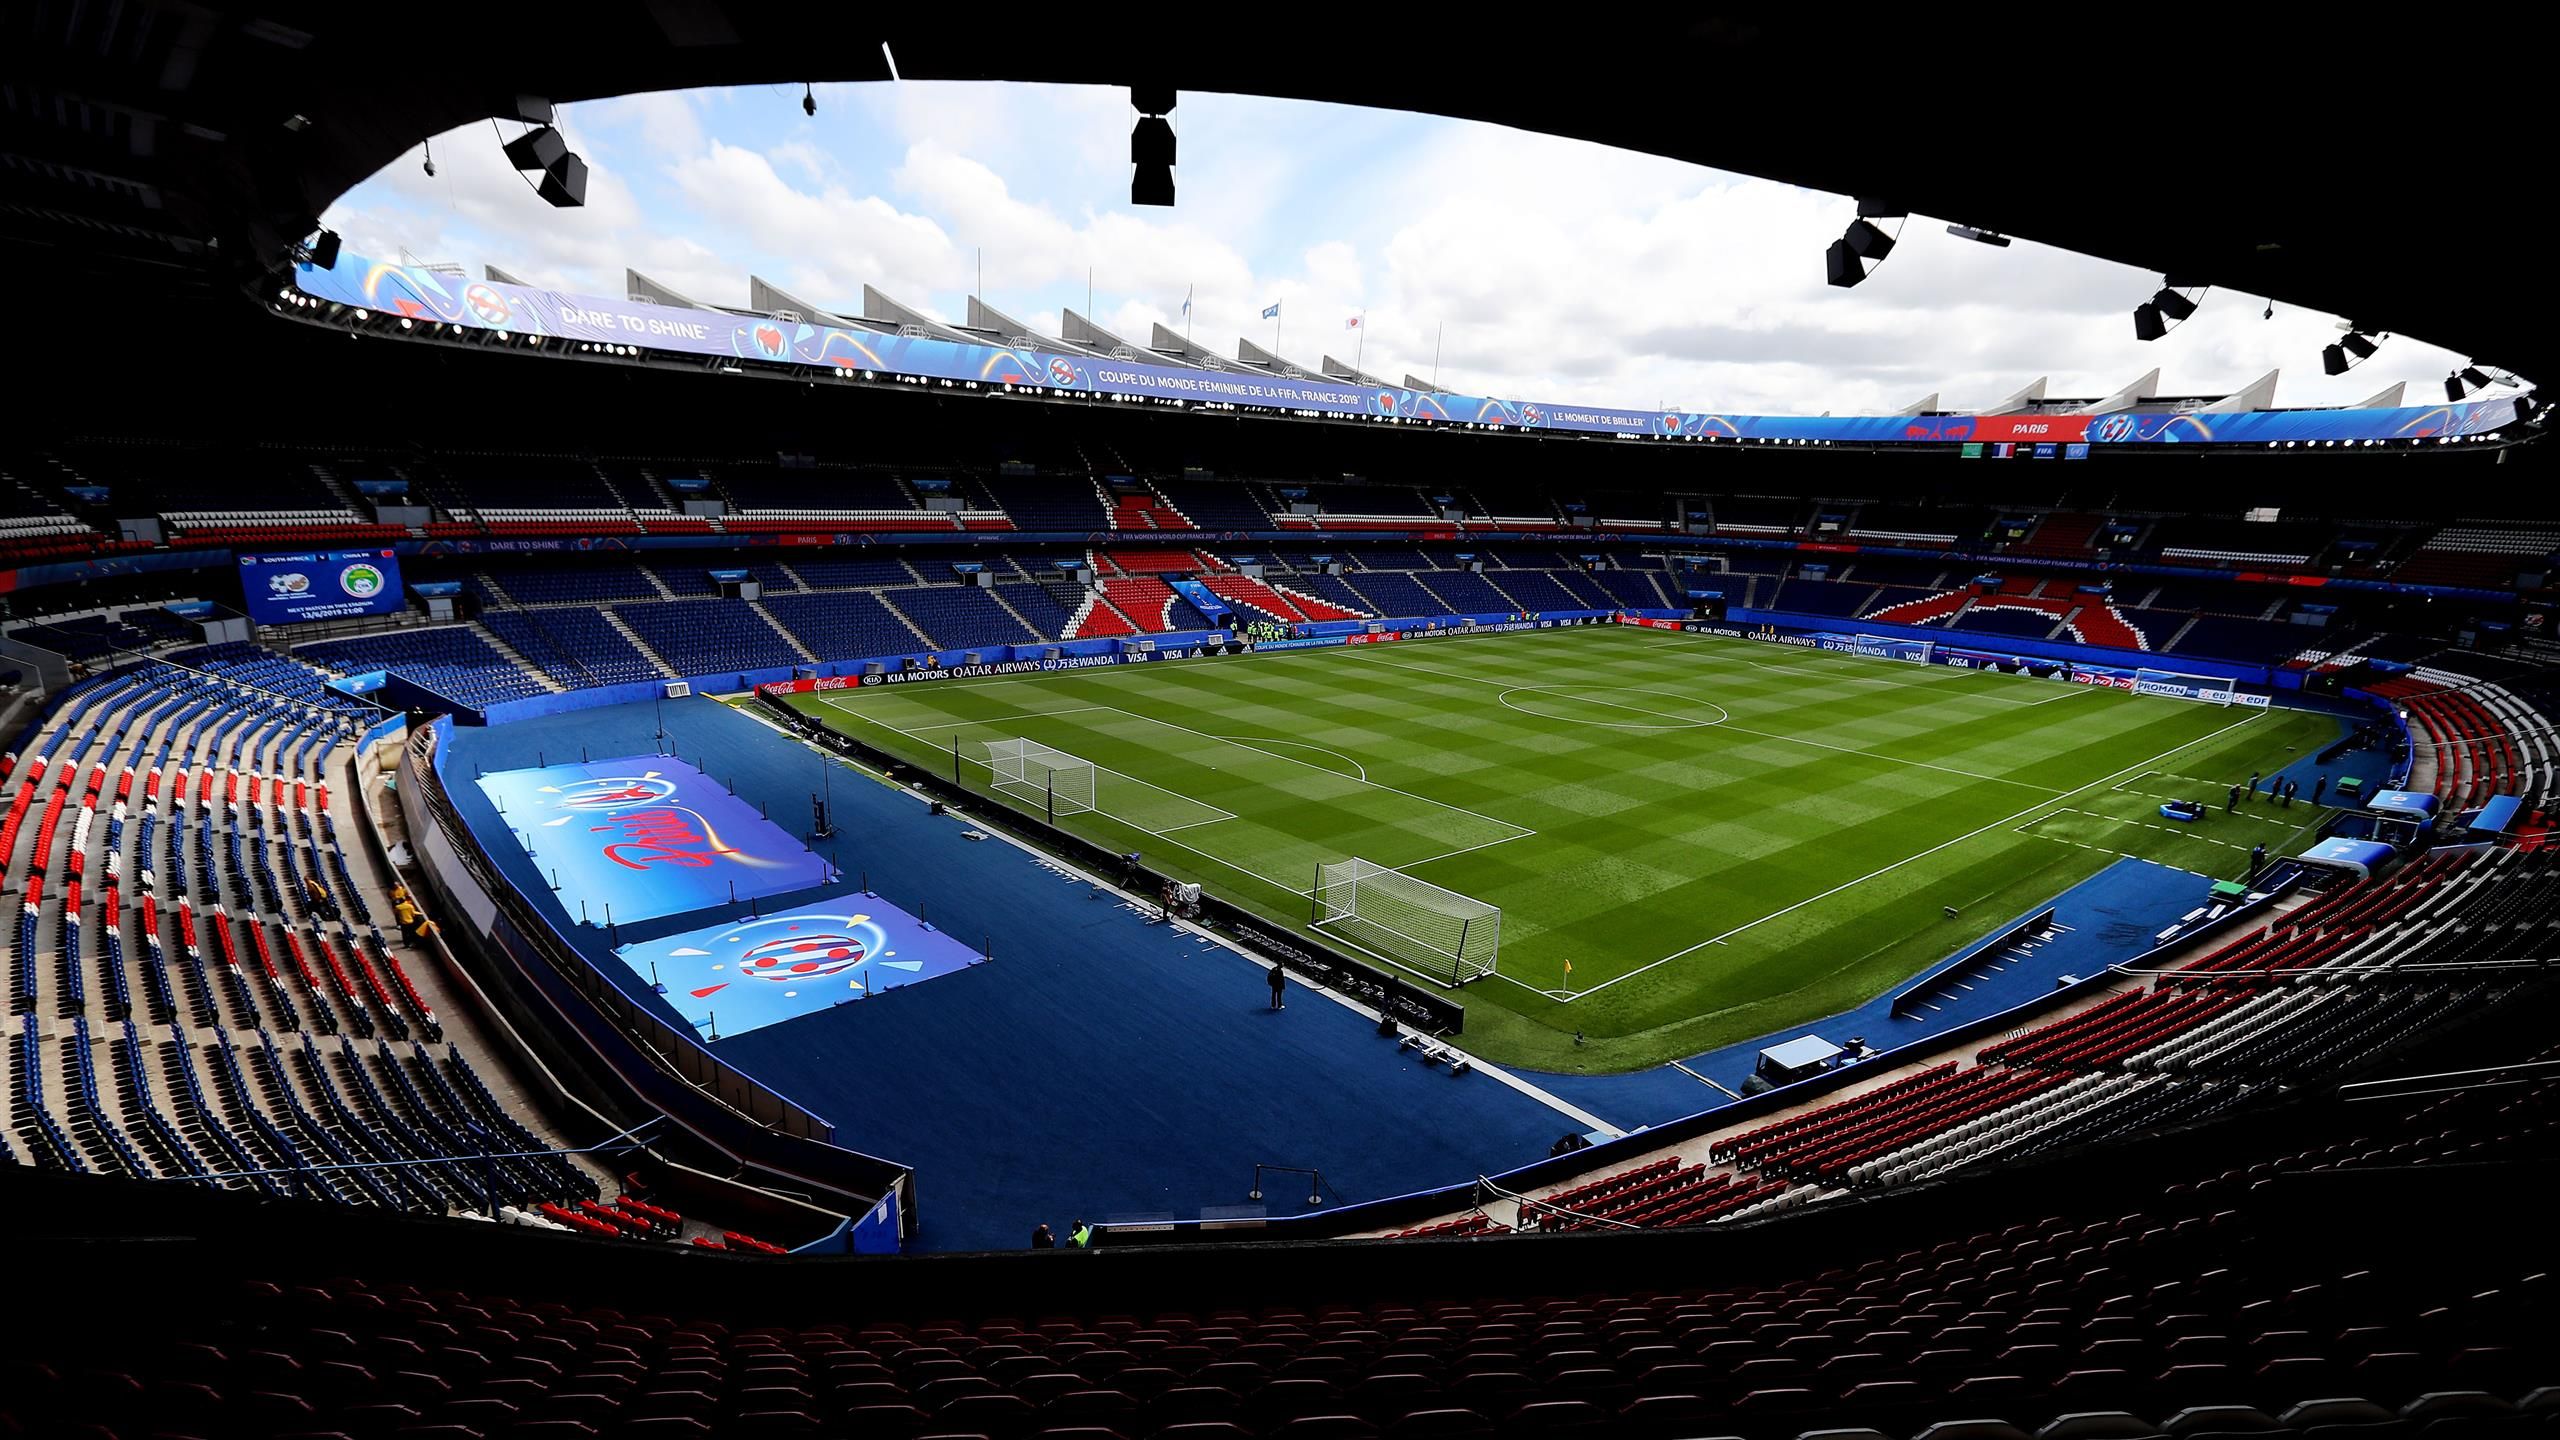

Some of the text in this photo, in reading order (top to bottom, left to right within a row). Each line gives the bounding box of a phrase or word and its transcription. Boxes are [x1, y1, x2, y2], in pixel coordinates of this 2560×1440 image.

[560, 306, 616, 329] DARE
[618, 314, 645, 332] TO
[1098, 370, 1138, 384] COUPE
[1138, 374, 1155, 386] DU
[1158, 376, 1198, 390] MONDE
[1199, 379, 1248, 396] FÉMININE
[1249, 386, 1262, 396] DE
[1264, 387, 1278, 398] LA
[1278, 388, 1300, 400] FIFA,
[1302, 390, 1338, 403] FRANCE
[1554, 412, 1564, 420] LE
[1565, 413, 1600, 424] MOMENT
[1600, 416, 1612, 424] DE
[2012, 424, 2049, 434] PARIS
[490, 542, 514, 550] DARE
[302, 606, 364, 619] 13/6/2019 21:00
[1448, 624, 1494, 636] QATAR AIRWAYS
[1713, 628, 1741, 638] MOTORS
[1748, 632, 1816, 647] QATAR AIRWAYS
[1162, 650, 1182, 660] VISA
[1856, 646, 1887, 656] WANDA
[1904, 652, 1926, 662] VISA
[1079, 656, 1114, 668] WANDA
[1126, 652, 1148, 663] VISA
[1946, 656, 1969, 667] VISA
[953, 661, 1040, 678] QATAR AIRWAYS
[1058, 659, 1079, 670] 万达
[887, 669, 949, 683] KIA MOTORS
[814, 677, 847, 690] Coca-Cola
[2138, 682, 2184, 695] PROMAN
[590, 810, 740, 870] Paris
